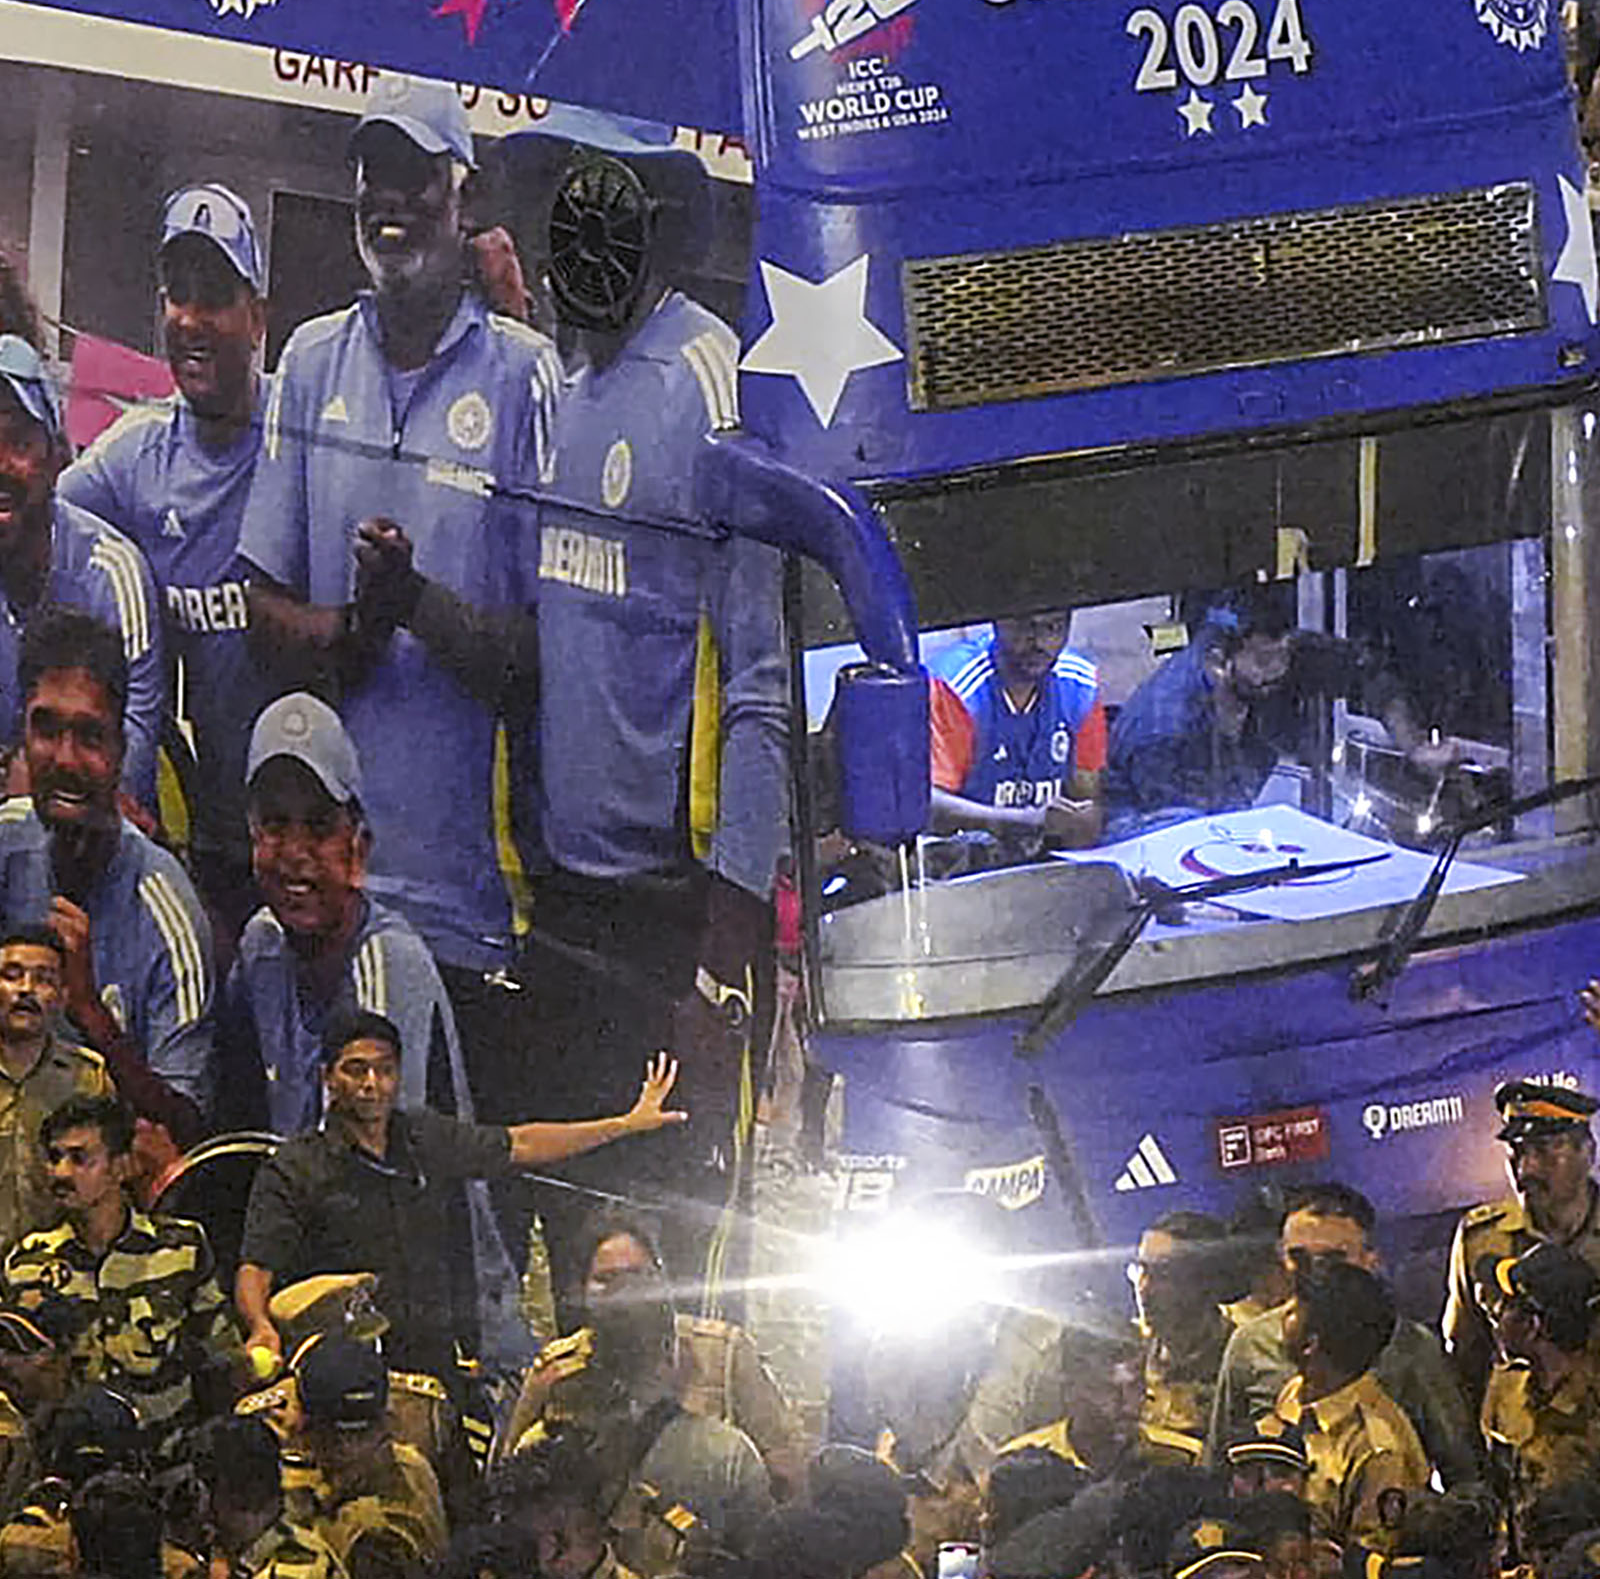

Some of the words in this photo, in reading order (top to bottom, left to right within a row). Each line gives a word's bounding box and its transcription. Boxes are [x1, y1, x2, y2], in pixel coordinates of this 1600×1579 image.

[848, 59, 883, 80] ICC
[801, 92, 891, 125] WORLD
[894, 86, 939, 110] CUP
